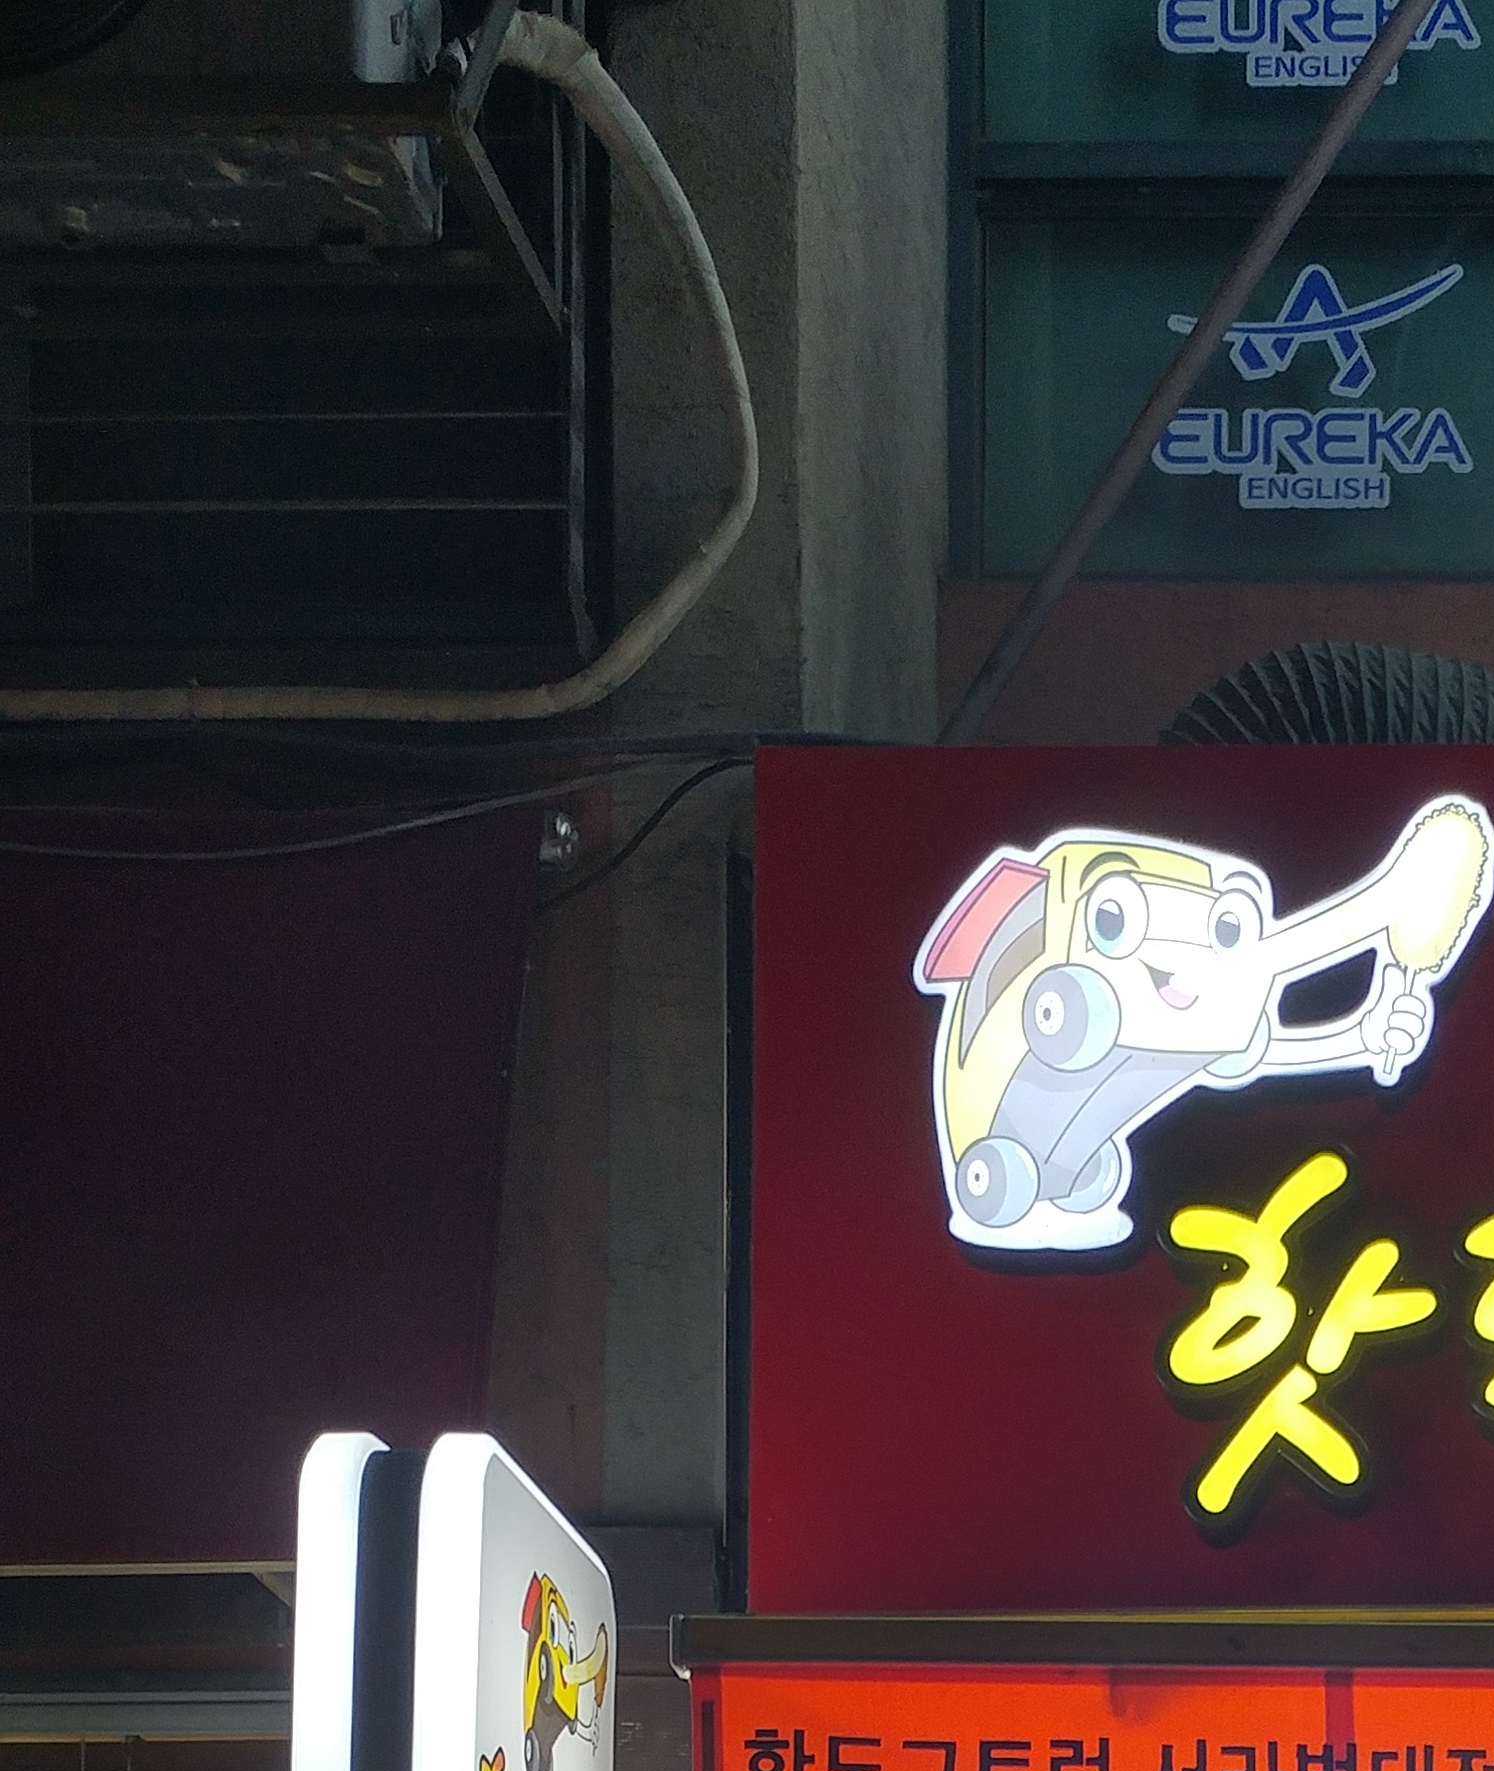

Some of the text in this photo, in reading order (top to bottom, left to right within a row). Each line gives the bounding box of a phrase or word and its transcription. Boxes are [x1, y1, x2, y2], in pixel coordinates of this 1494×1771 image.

[1254, 56, 1366, 78] ENGLIS
[1159, 413, 1467, 464] EUREKA
[1248, 478, 1385, 499] ENGLISH
